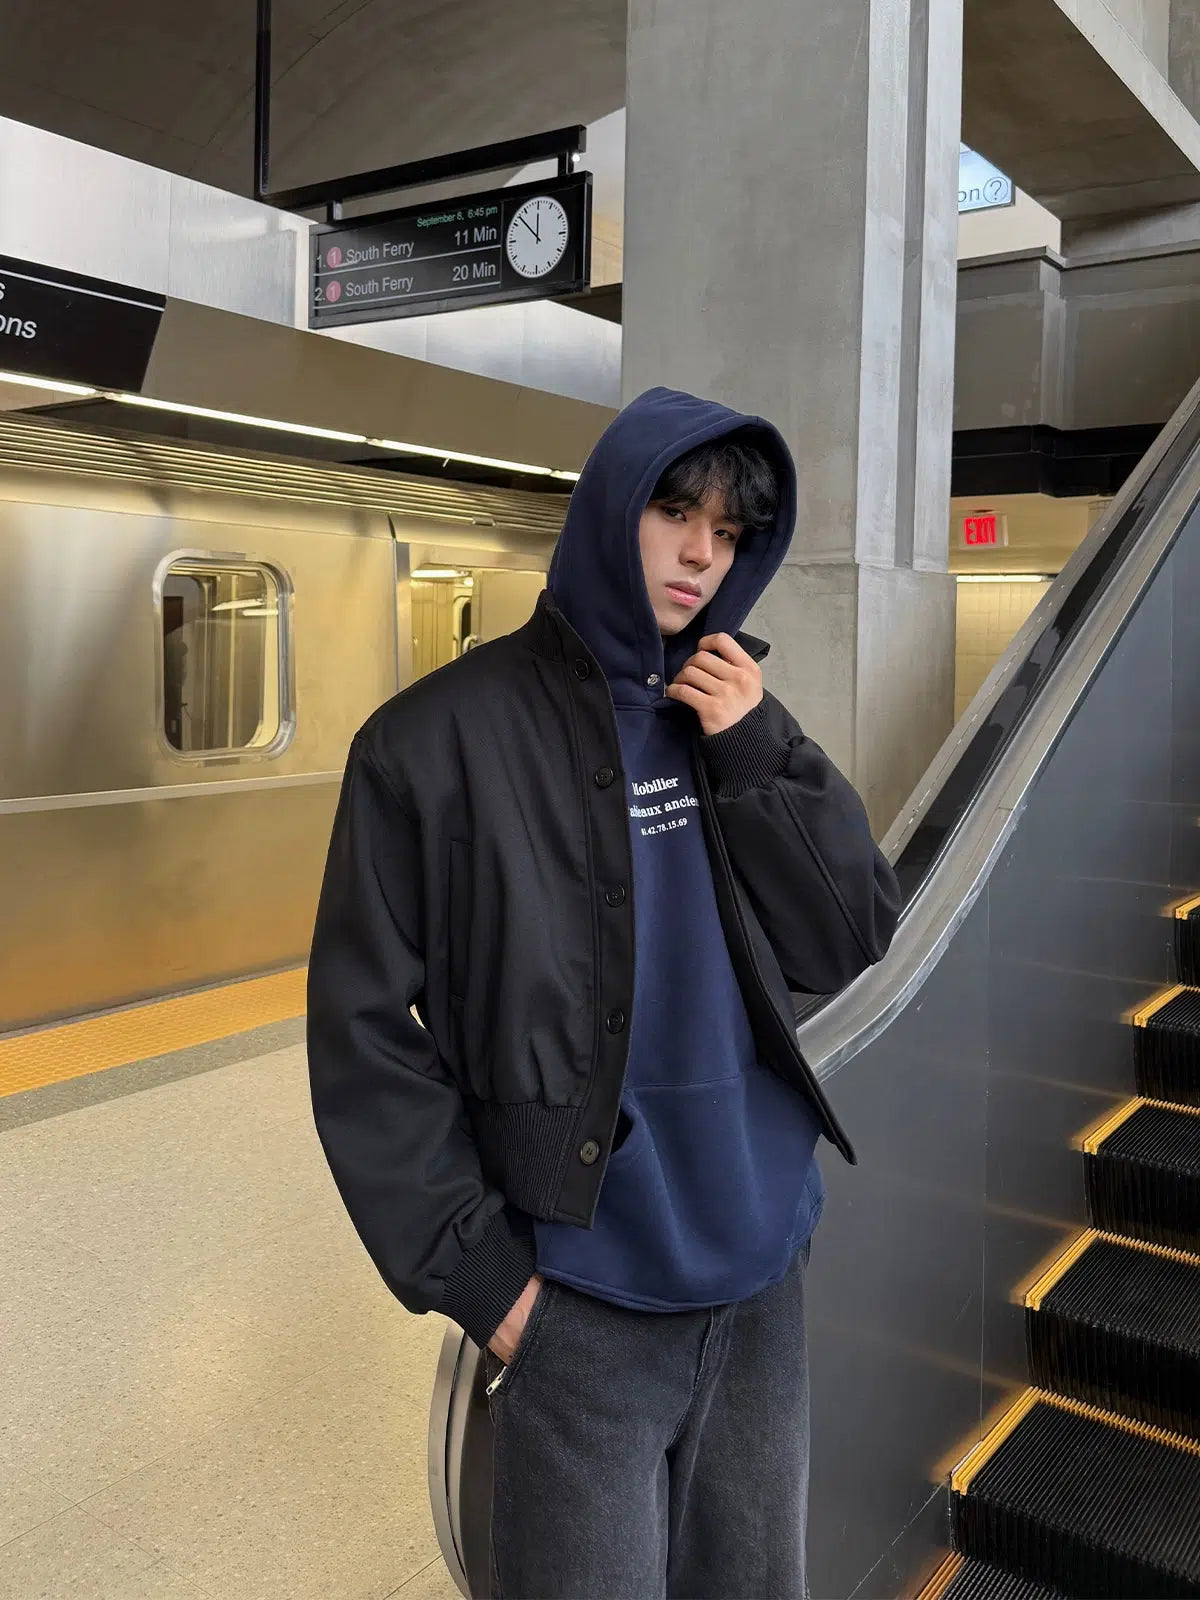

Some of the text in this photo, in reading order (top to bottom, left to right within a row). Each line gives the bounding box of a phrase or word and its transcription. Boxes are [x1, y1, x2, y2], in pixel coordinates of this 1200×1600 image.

[417, 213, 455, 228] September
[467, 207, 484, 219] 6:45
[486, 206, 498, 216] pm
[316, 255, 327, 268] 1.
[346, 245, 380, 264] South
[382, 241, 415, 258] Ferry
[454, 229, 469, 246] 11
[473, 225, 497, 244] Min
[314, 287, 326, 302] 2.
[345, 279, 379, 297] South
[382, 276, 414, 293] Ferry
[452, 264, 469, 281] 20
[472, 261, 497, 279] Min
[965, 517, 996, 545] EXIT
